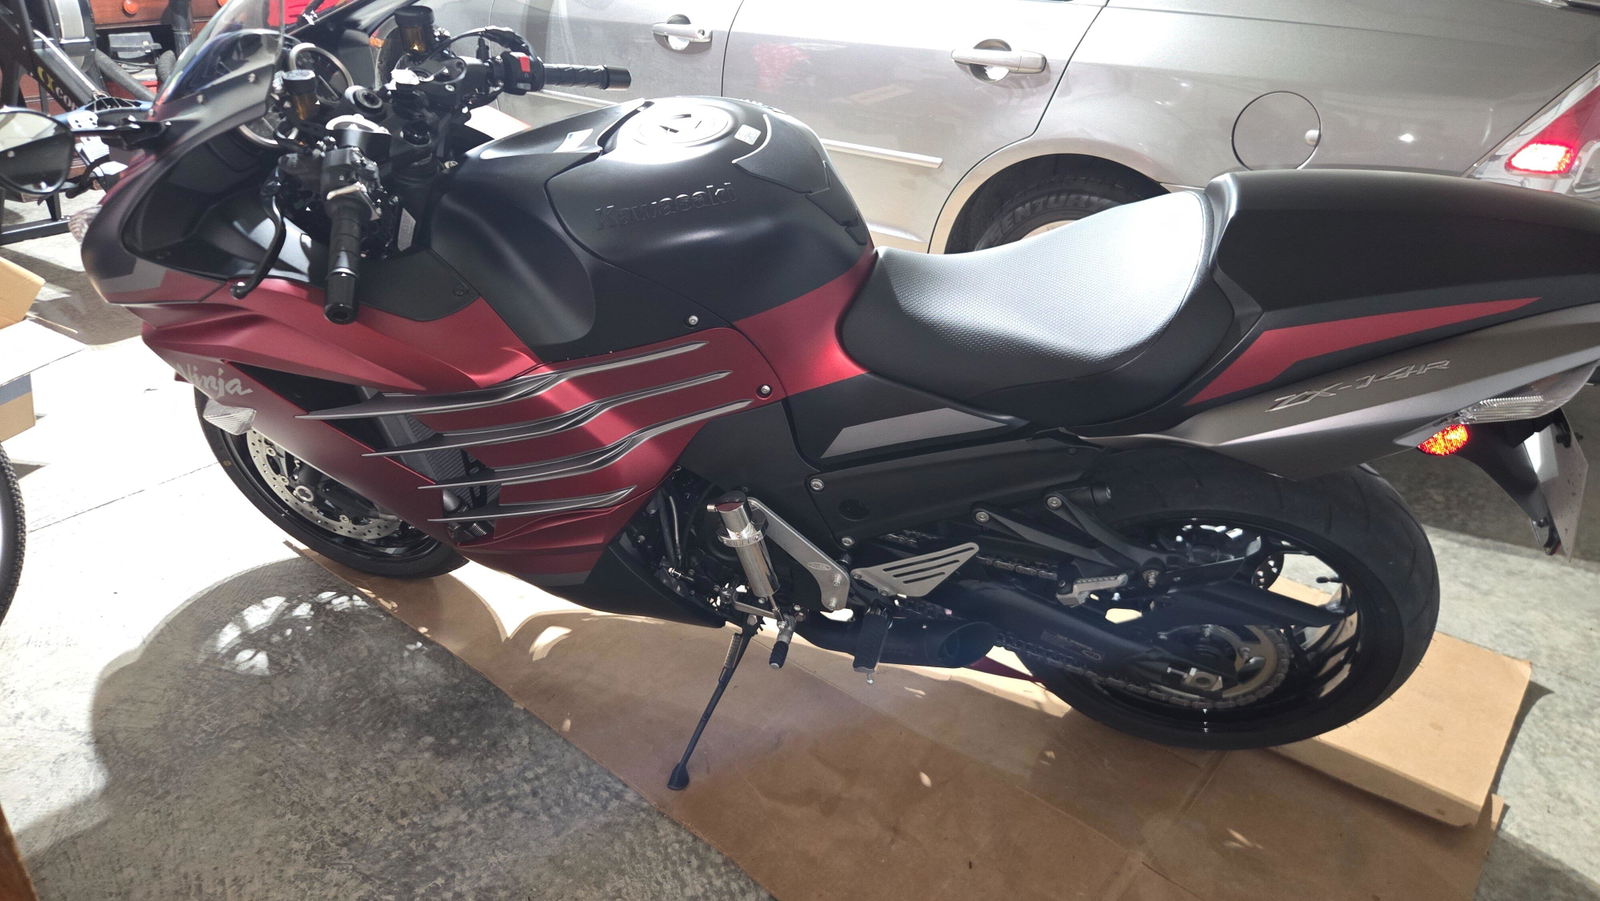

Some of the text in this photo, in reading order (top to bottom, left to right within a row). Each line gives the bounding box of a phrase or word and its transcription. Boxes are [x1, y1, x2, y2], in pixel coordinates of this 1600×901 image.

[594, 181, 738, 230] Kawasaki
[176, 363, 253, 399] Ninja
[1264, 359, 1450, 413] ZX-14R
